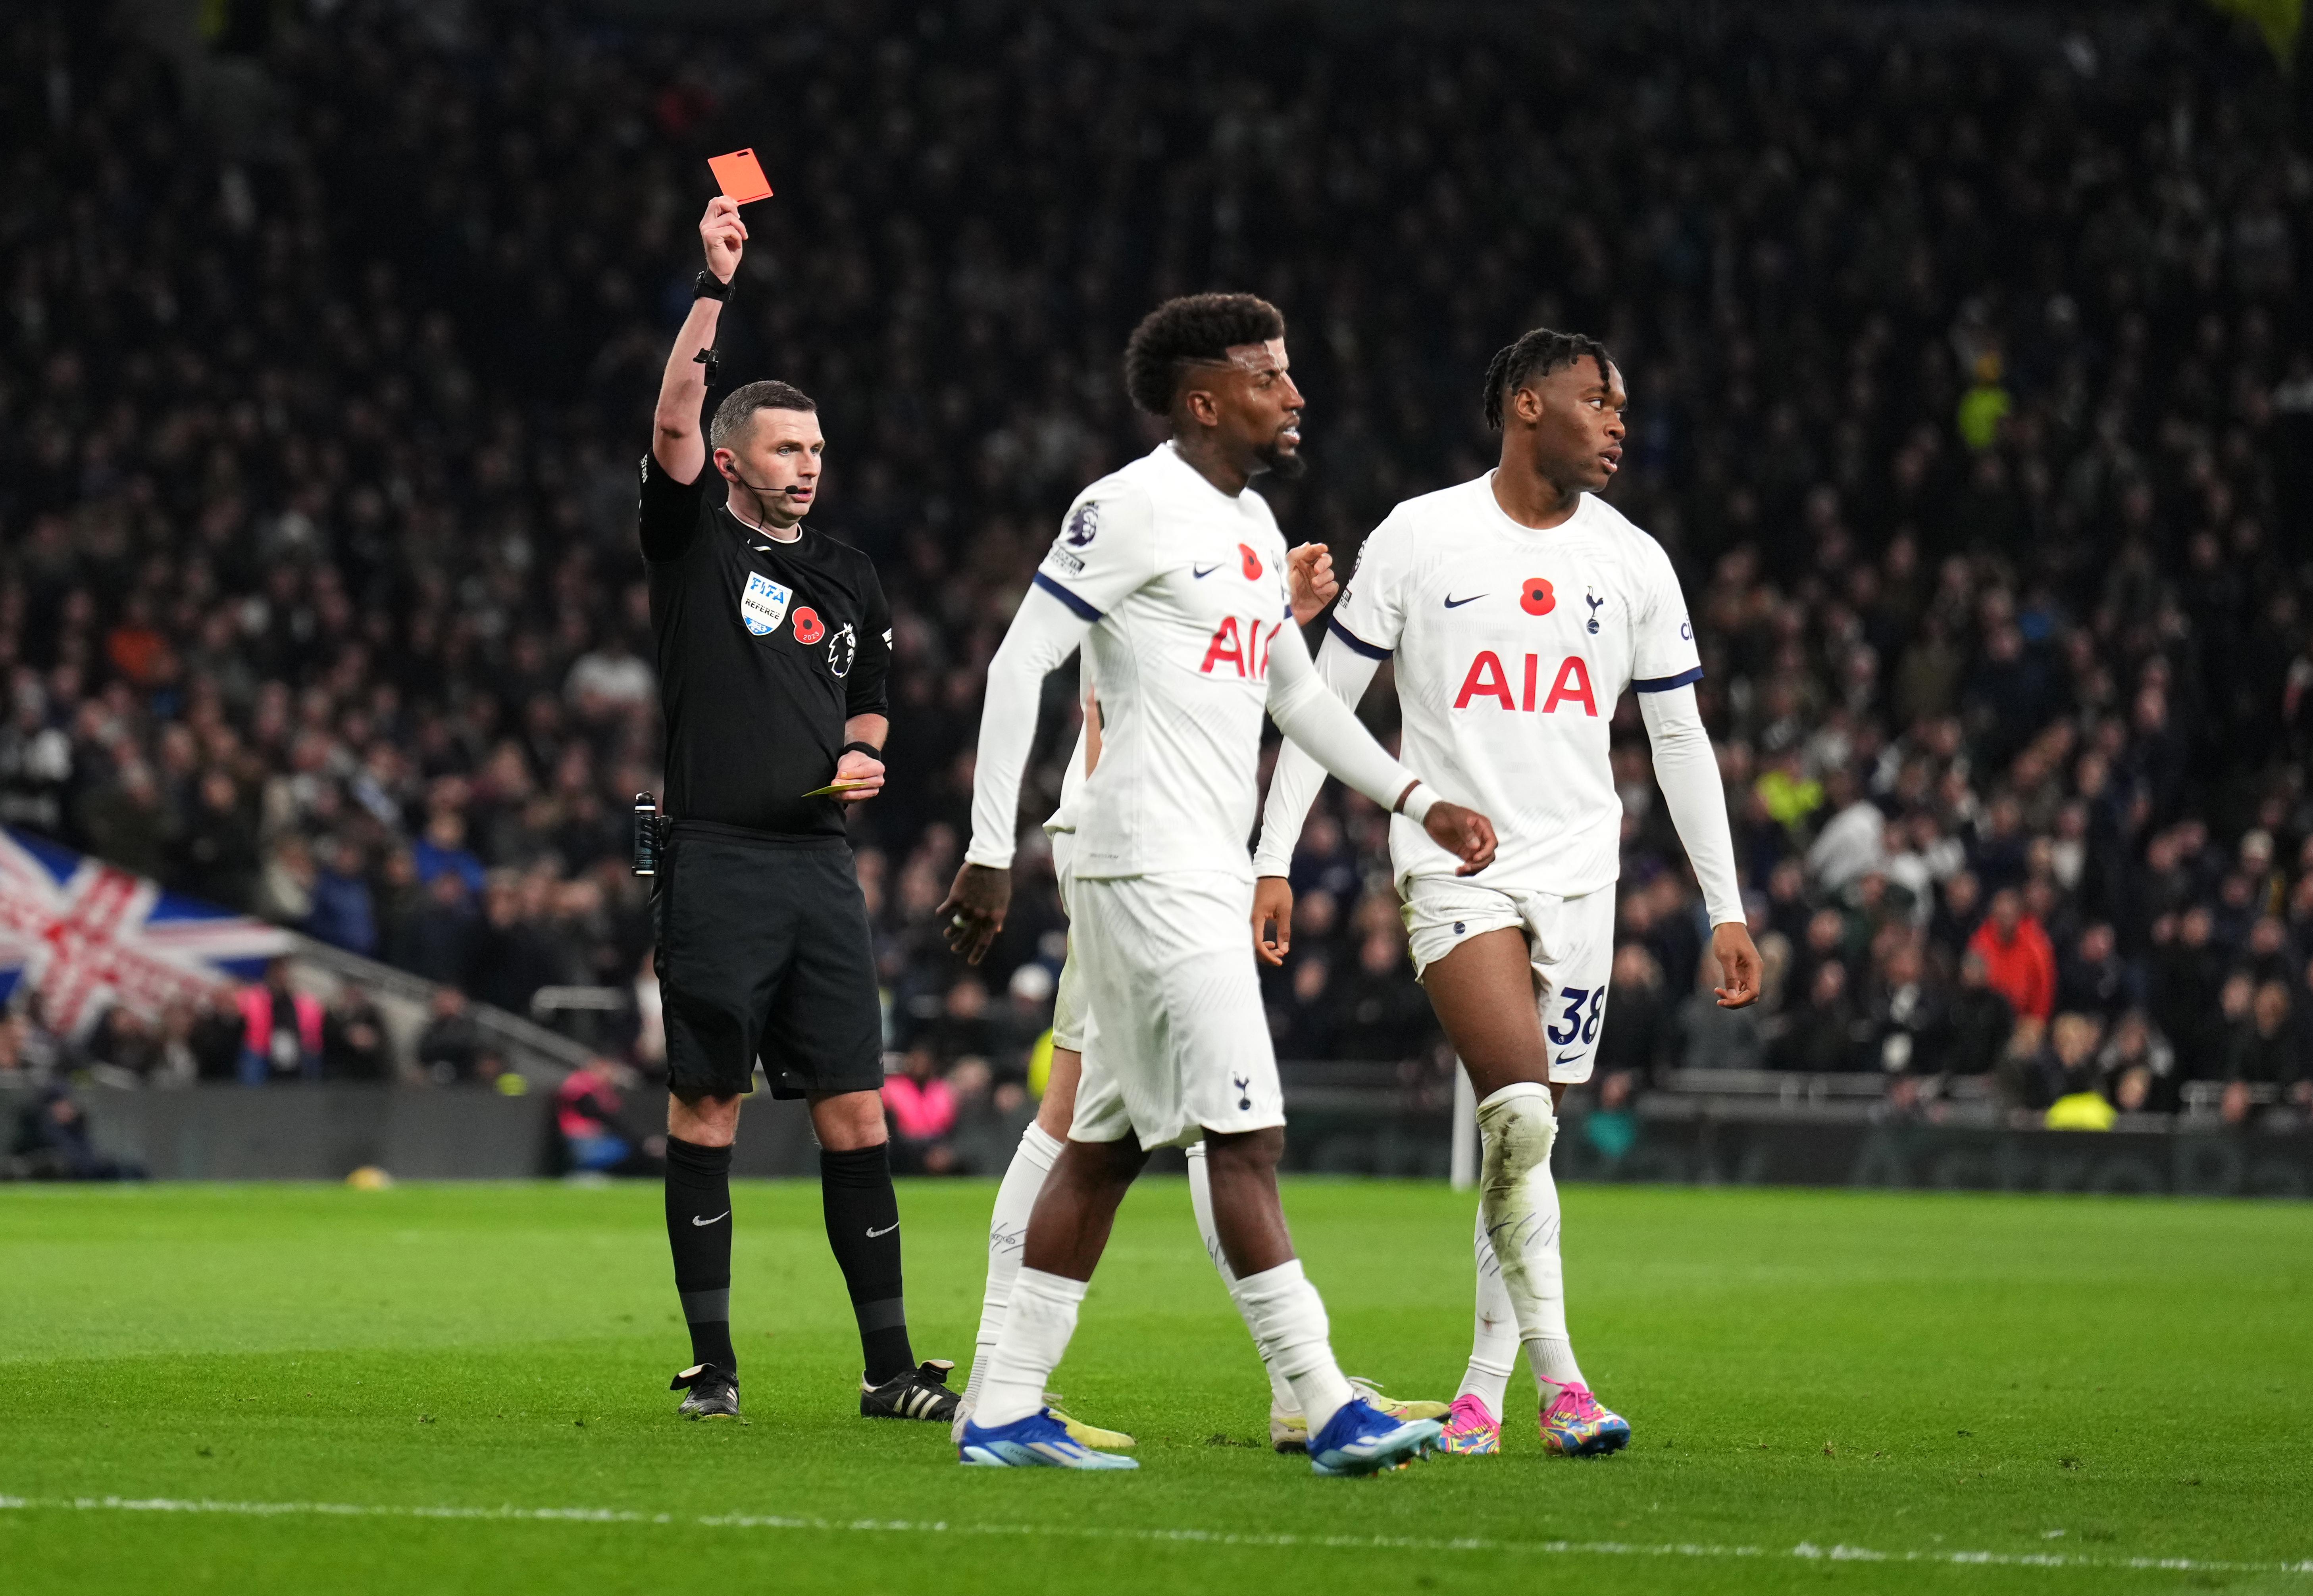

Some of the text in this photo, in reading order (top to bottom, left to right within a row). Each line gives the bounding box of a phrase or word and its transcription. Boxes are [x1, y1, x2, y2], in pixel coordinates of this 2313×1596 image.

[750, 577, 784, 604] FIFA
[745, 598, 780, 620] REFEREE
[748, 620, 768, 633] 2023
[802, 631, 820, 640] 2023
[1453, 650, 1599, 717] AIA
[1547, 985, 1605, 1045] 38
